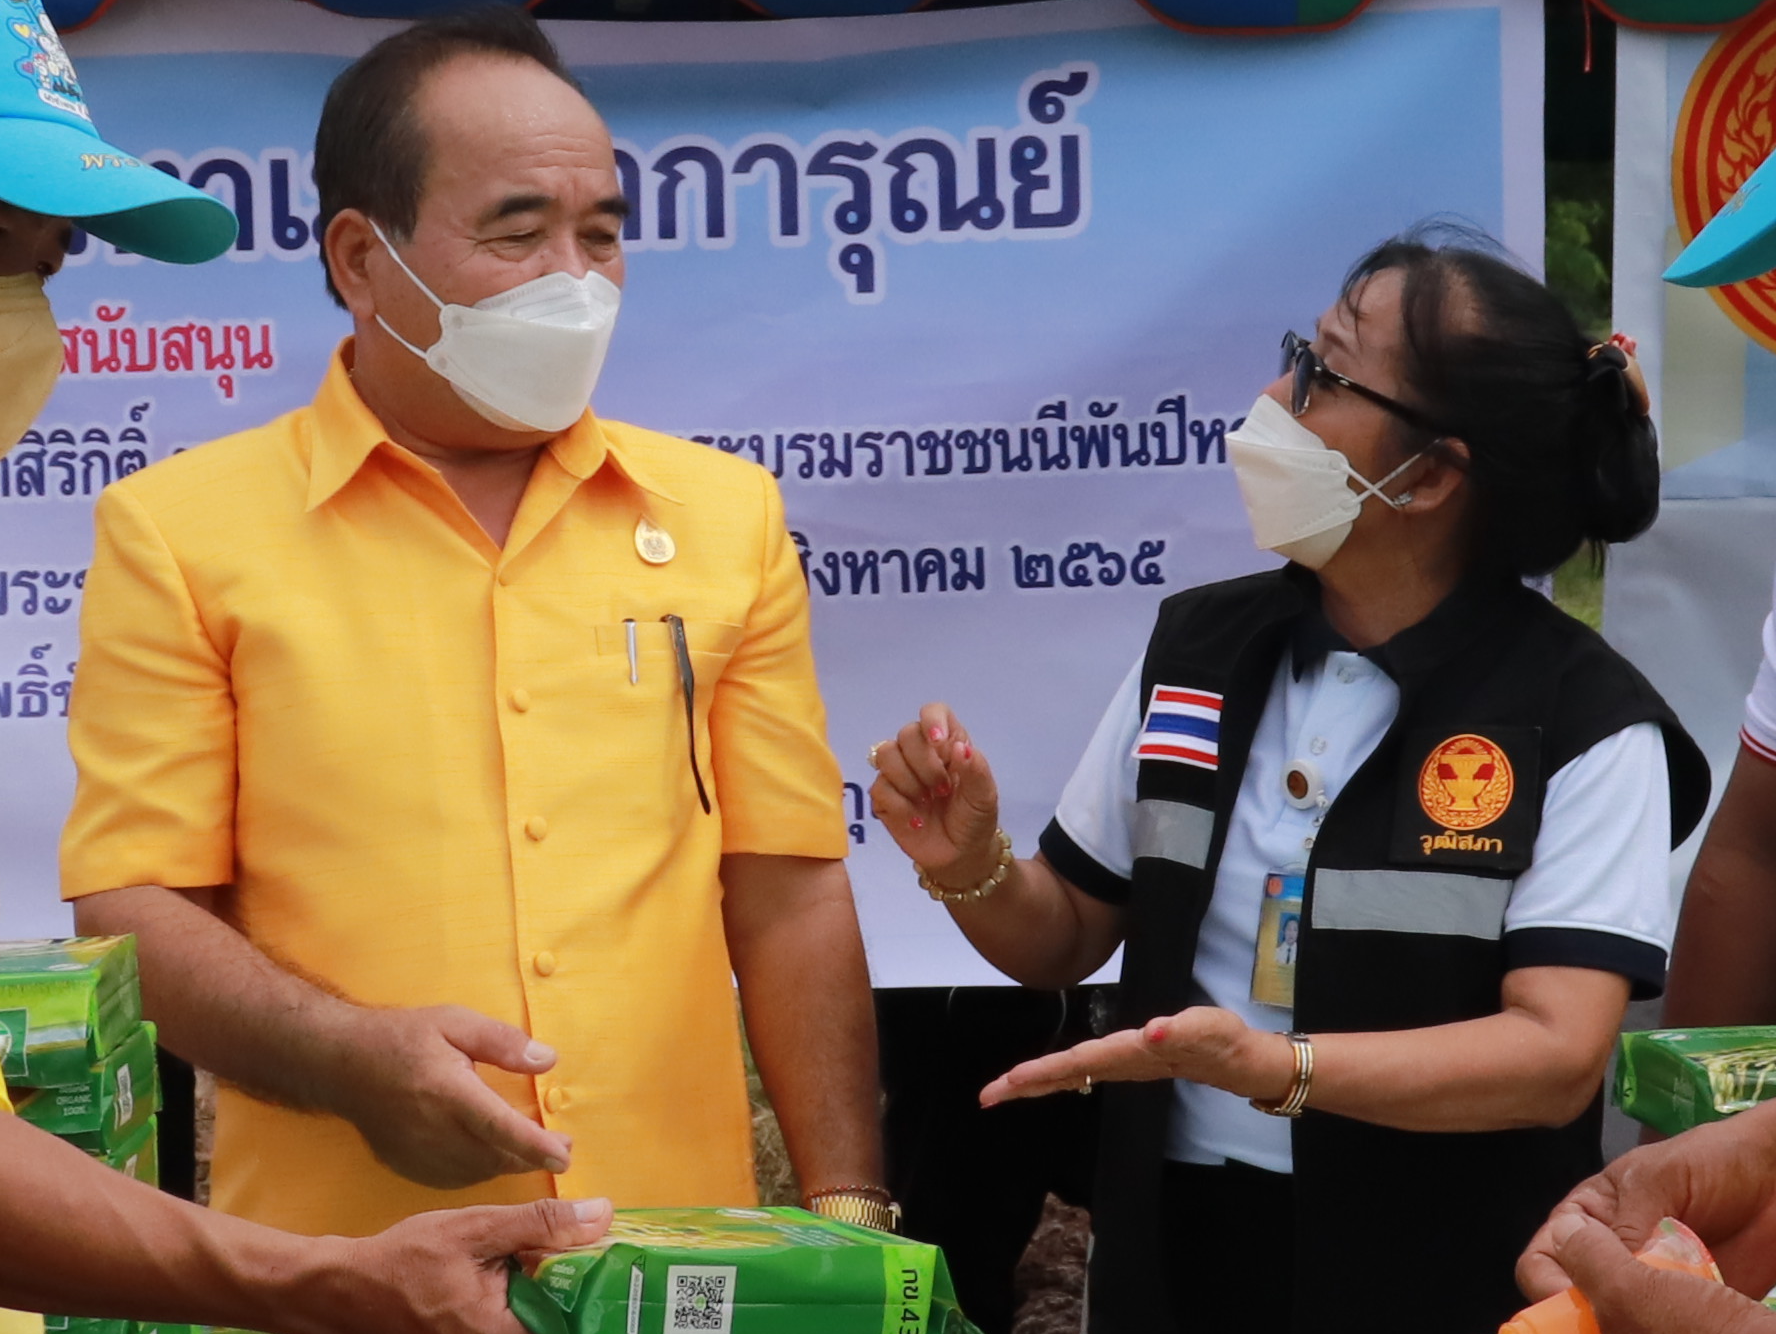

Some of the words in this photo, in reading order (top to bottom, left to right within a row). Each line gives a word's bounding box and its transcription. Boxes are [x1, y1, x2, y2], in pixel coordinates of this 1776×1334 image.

[1011, 539, 1166, 590] ๒๕๖๕
[1419, 829, 1503, 856] วุฒิสภา
